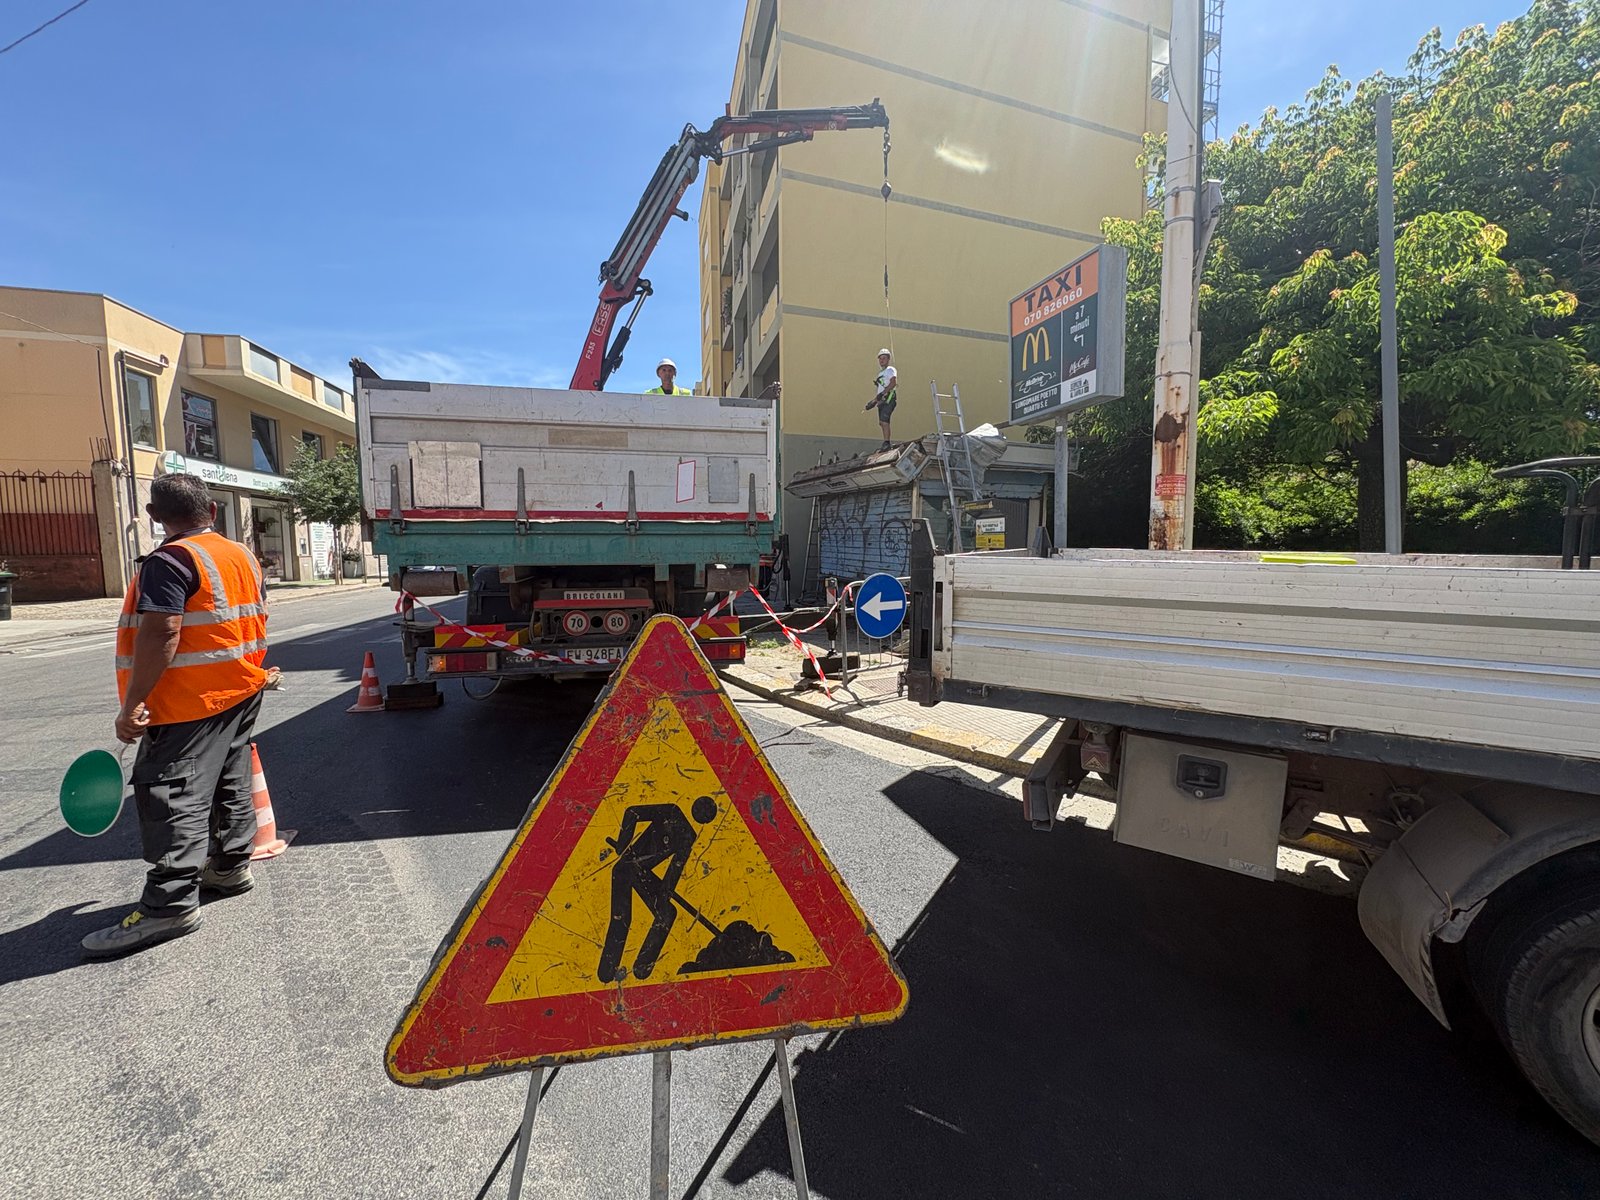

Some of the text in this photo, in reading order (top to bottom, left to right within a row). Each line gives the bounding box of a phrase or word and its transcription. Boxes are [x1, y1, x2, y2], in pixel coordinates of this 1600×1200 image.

[1025, 264, 1081, 313] TAXI
[1024, 287, 1083, 326] 070 826060
[594, 302, 611, 334] FASS
[1070, 315, 1090, 335] minuti
[1040, 387, 1058, 400] POETTO
[571, 618, 583, 628] 70
[611, 617, 623, 627] 80
